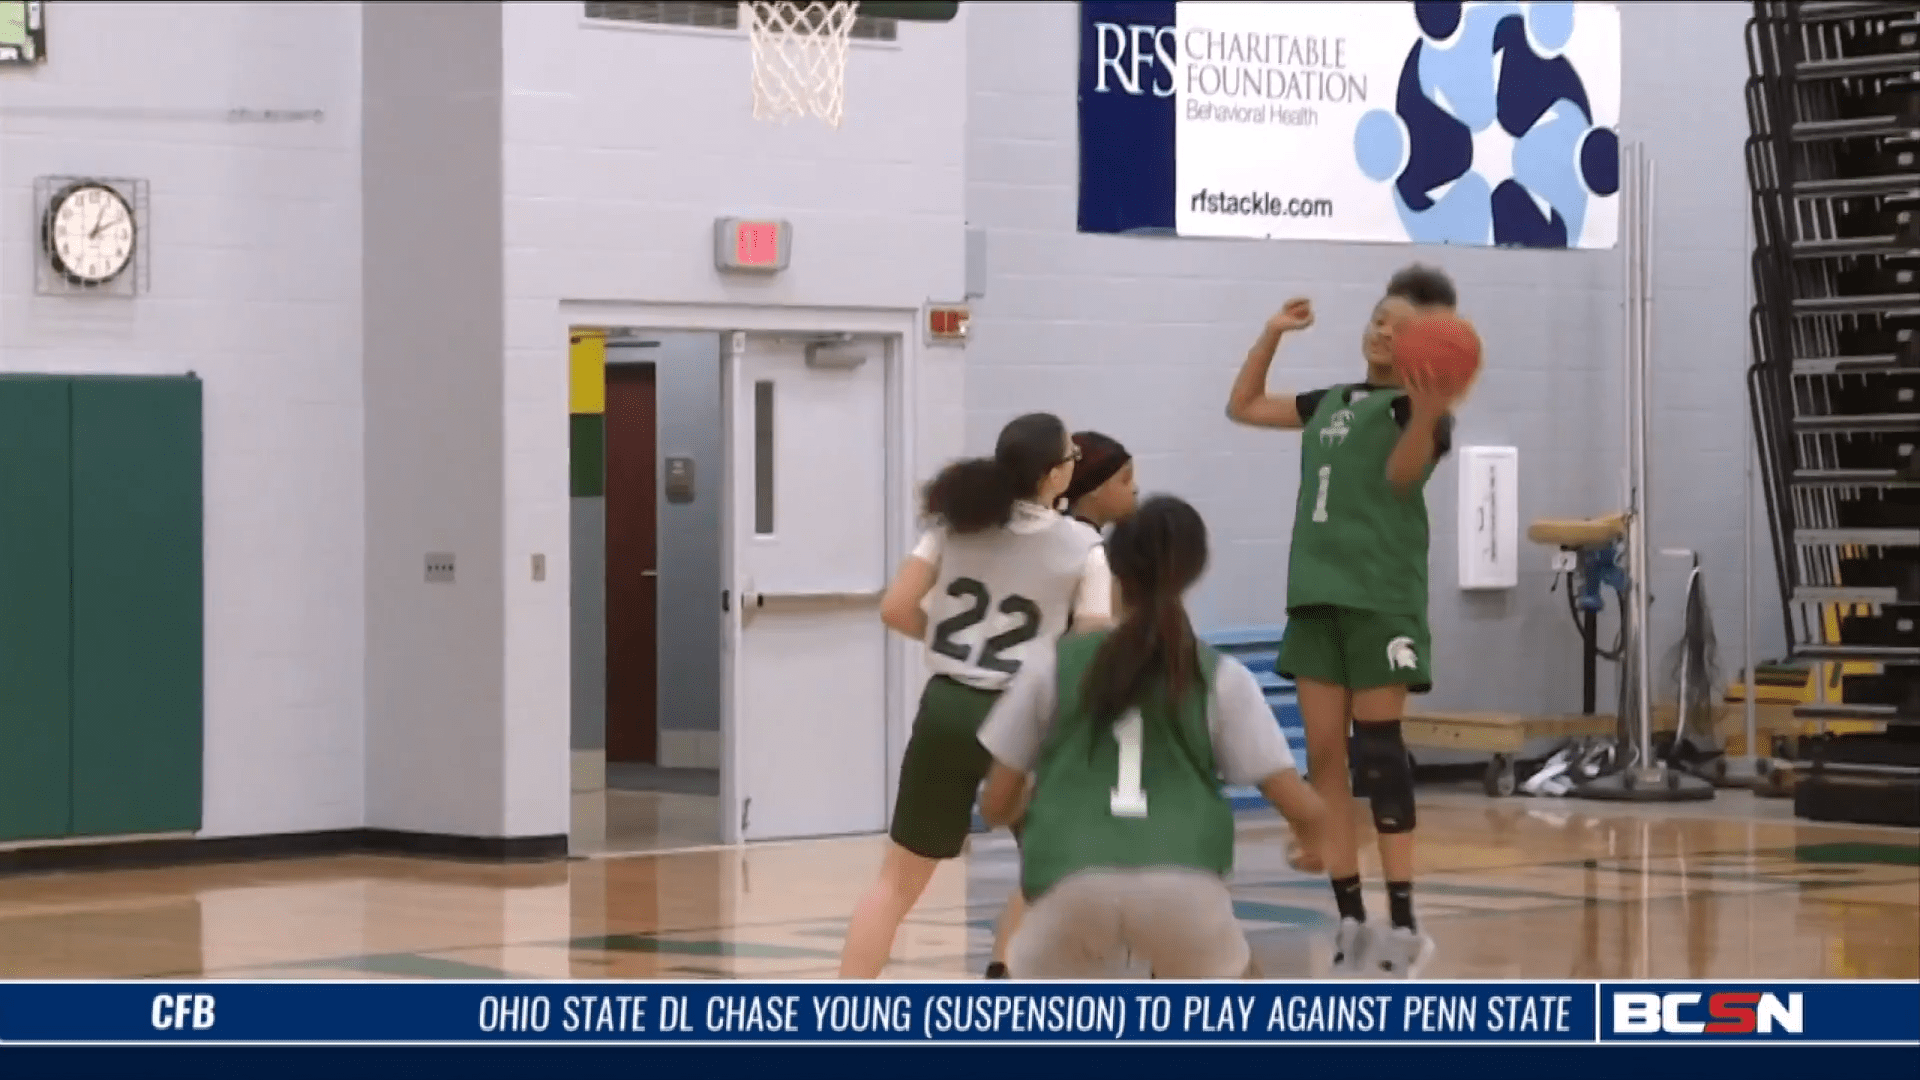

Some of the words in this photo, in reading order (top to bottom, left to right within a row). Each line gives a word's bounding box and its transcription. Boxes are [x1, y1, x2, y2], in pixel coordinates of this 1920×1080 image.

[1094, 23, 1175, 98] RFS
[1184, 28, 1347, 69] CHARITABLE
[1187, 63, 1368, 103] FOUNDATION
[1186, 98, 1266, 124] Behavioral
[1270, 103, 1319, 126] Health
[1190, 188, 1334, 218] rfstackle.com
[1312, 464, 1332, 523] 1
[931, 576, 1043, 674] 22
[1109, 706, 1148, 818] 1
